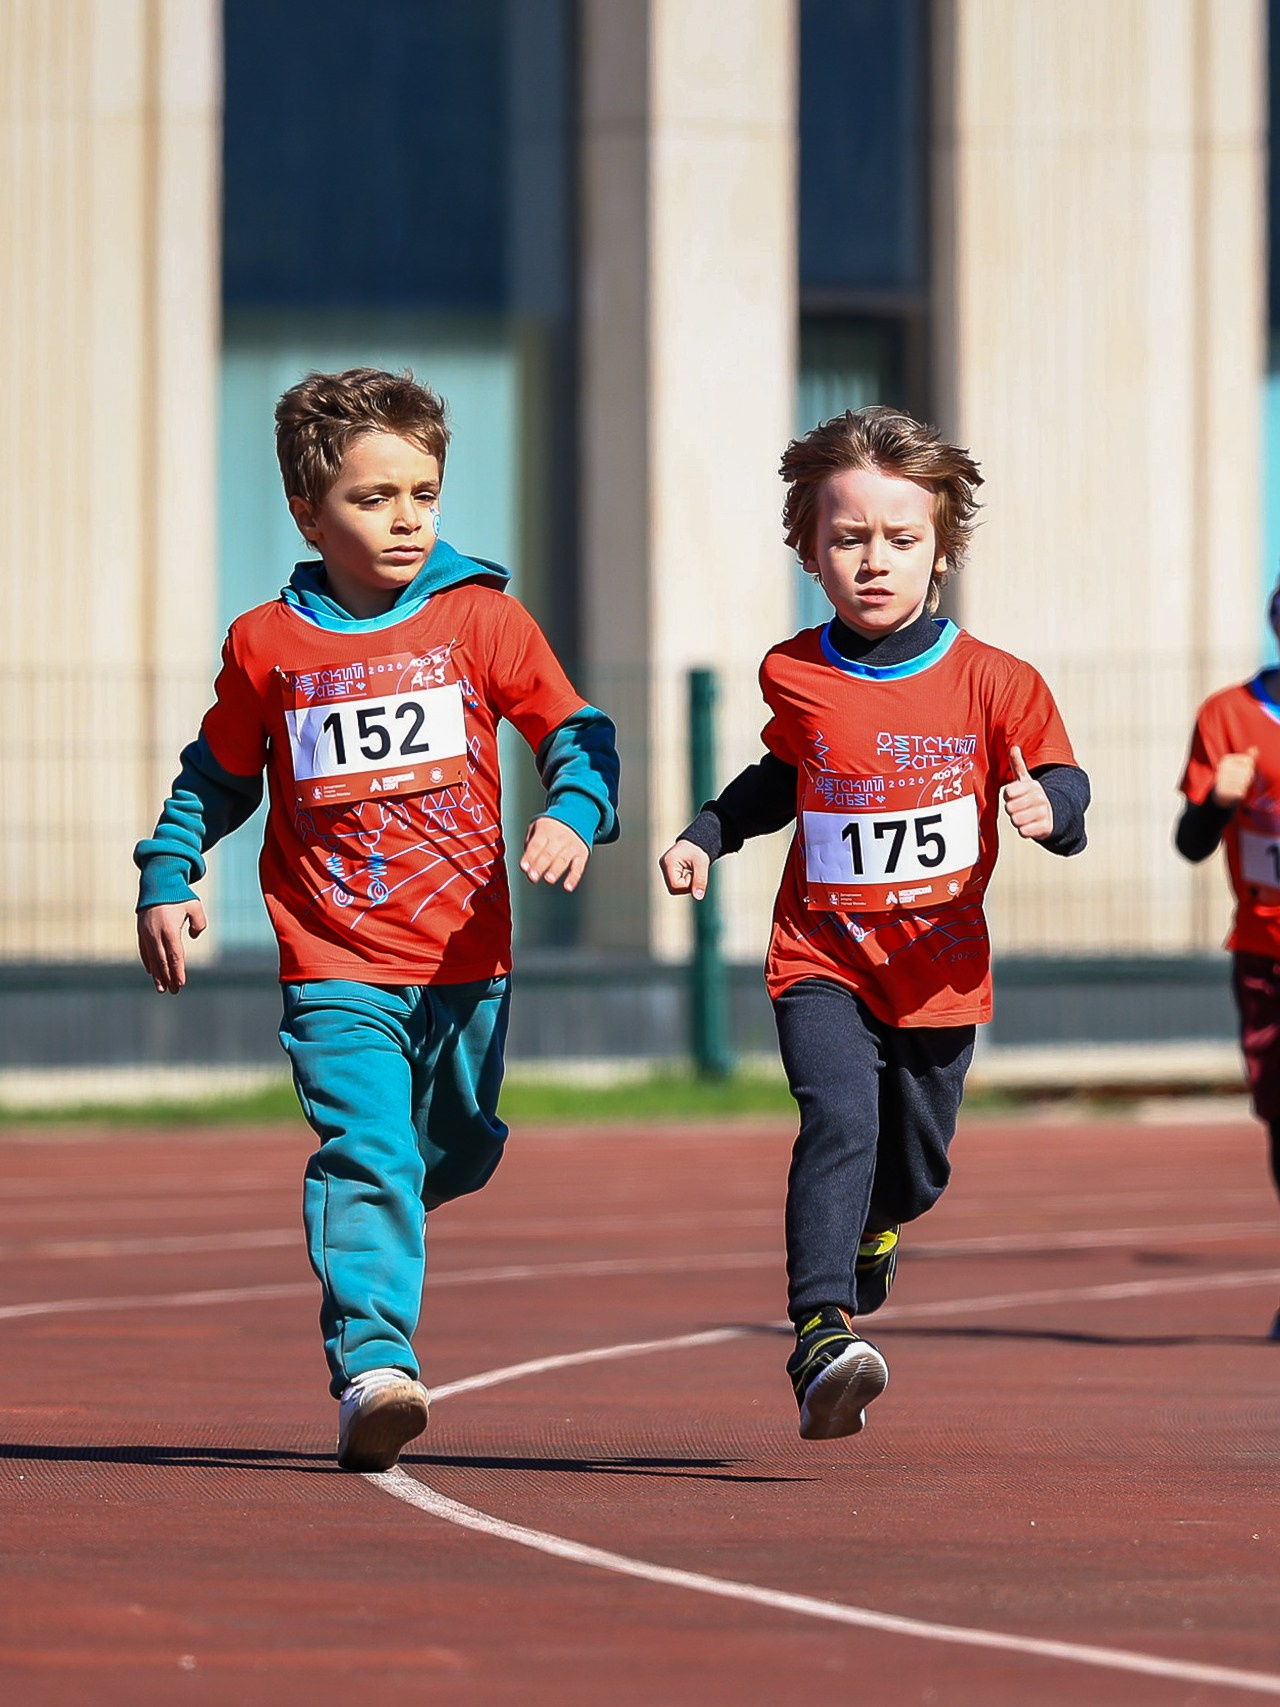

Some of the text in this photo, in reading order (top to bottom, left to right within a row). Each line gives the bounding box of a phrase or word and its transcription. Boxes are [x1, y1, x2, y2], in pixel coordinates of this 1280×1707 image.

[368, 663, 403, 675] 2026
[323, 701, 430, 765] 152
[877, 732, 977, 756] ДЕТСКИЙ
[888, 777, 925, 789] 2026
[841, 813, 947, 875] 175
